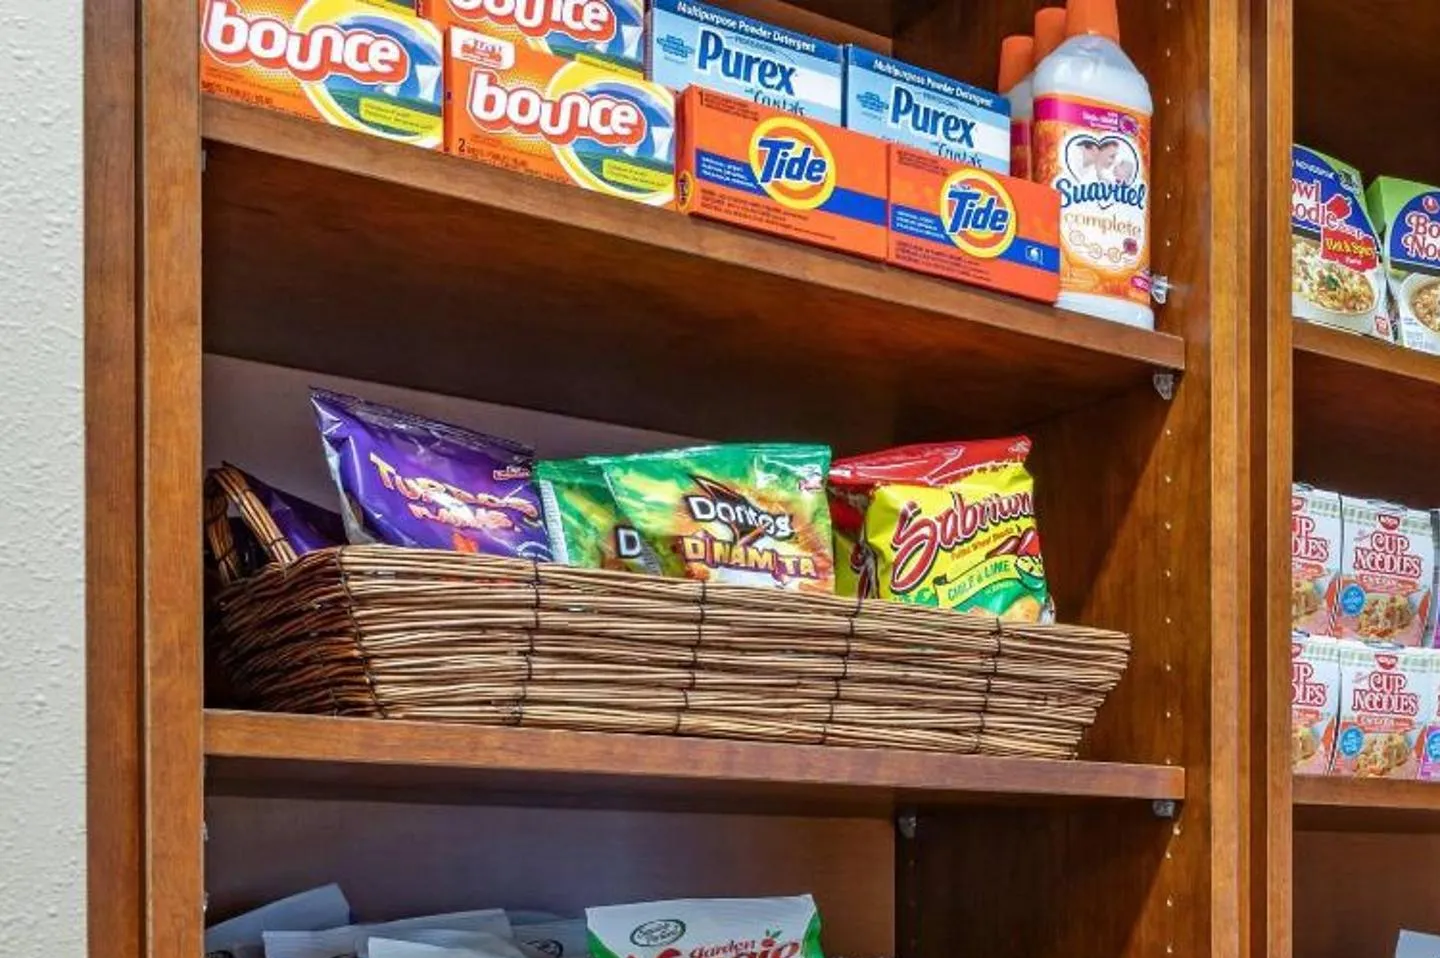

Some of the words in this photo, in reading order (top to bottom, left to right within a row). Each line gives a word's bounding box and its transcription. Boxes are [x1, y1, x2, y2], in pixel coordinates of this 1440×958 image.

[451, 0, 610, 32] unce
[207, 1, 401, 73] bounce
[738, 20, 771, 39] Powder
[773, 30, 815, 53] Detergent
[698, 30, 797, 96] Purex
[471, 71, 639, 135] bounce
[891, 86, 976, 148] Purex
[758, 138, 827, 184] Tide
[1056, 178, 1146, 210] Suavitel
[948, 190, 1009, 234] Tide
[1064, 211, 1141, 238] complete
[687, 496, 792, 538] Doritos
[1370, 532, 1408, 553] CUP
[1354, 547, 1422, 578] NOODLES
[1369, 672, 1407, 693] CUP
[1352, 690, 1419, 716] NOODLES
